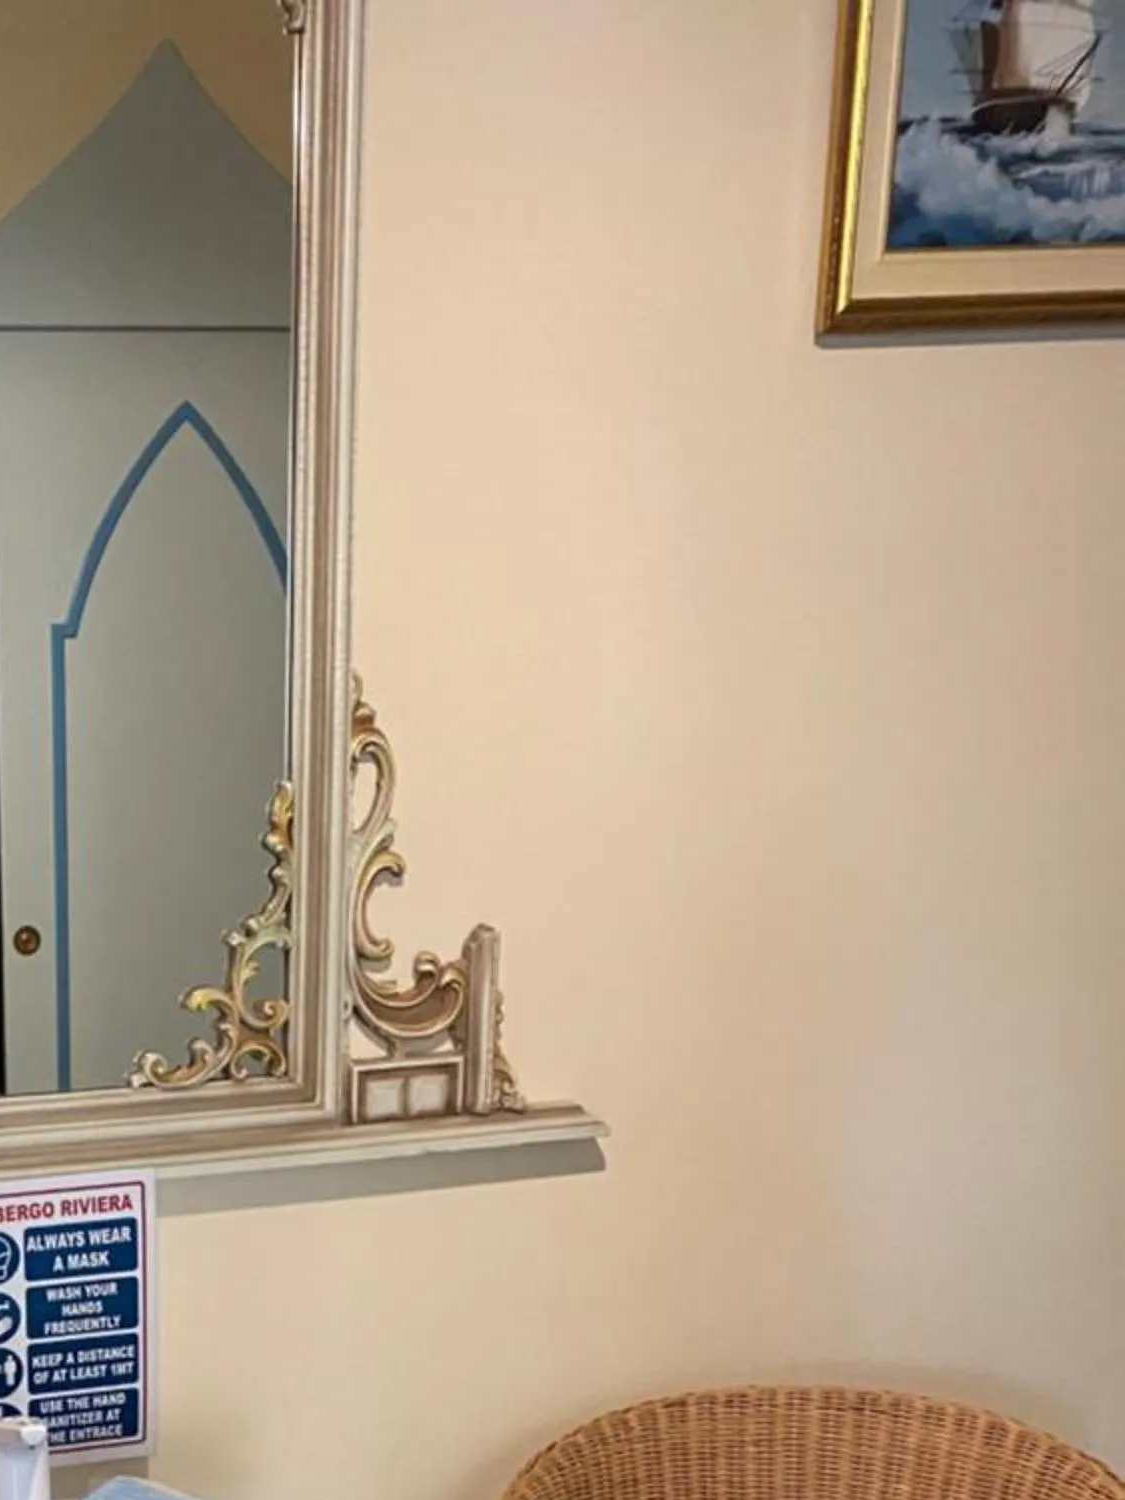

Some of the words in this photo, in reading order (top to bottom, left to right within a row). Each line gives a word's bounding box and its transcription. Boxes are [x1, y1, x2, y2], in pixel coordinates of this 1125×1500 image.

[60, 1194, 133, 1217] RIVIERA
[26, 1230, 85, 1252] ALWAYS
[87, 1226, 132, 1246] WEAR
[53, 1256, 65, 1272] A
[67, 1251, 110, 1270] MASK
[46, 1285, 82, 1302] WASH
[84, 1282, 118, 1298] YOUR
[61, 1300, 104, 1316] HANDS
[43, 1315, 121, 1337] FREQUENTLY
[32, 1352, 63, 1368] KEEP
[66, 1351, 75, 1364] A
[77, 1345, 135, 1363] DISTANCE
[32, 1370, 50, 1385] OF
[52, 1368, 67, 1382] AT
[70, 1364, 107, 1381] LEAST
[39, 1399, 63, 1413] USE
[67, 1395, 90, 1411] THE
[92, 1391, 126, 1407] HAND
[106, 1407, 121, 1422] AT
[49, 1429, 66, 1443] HE
